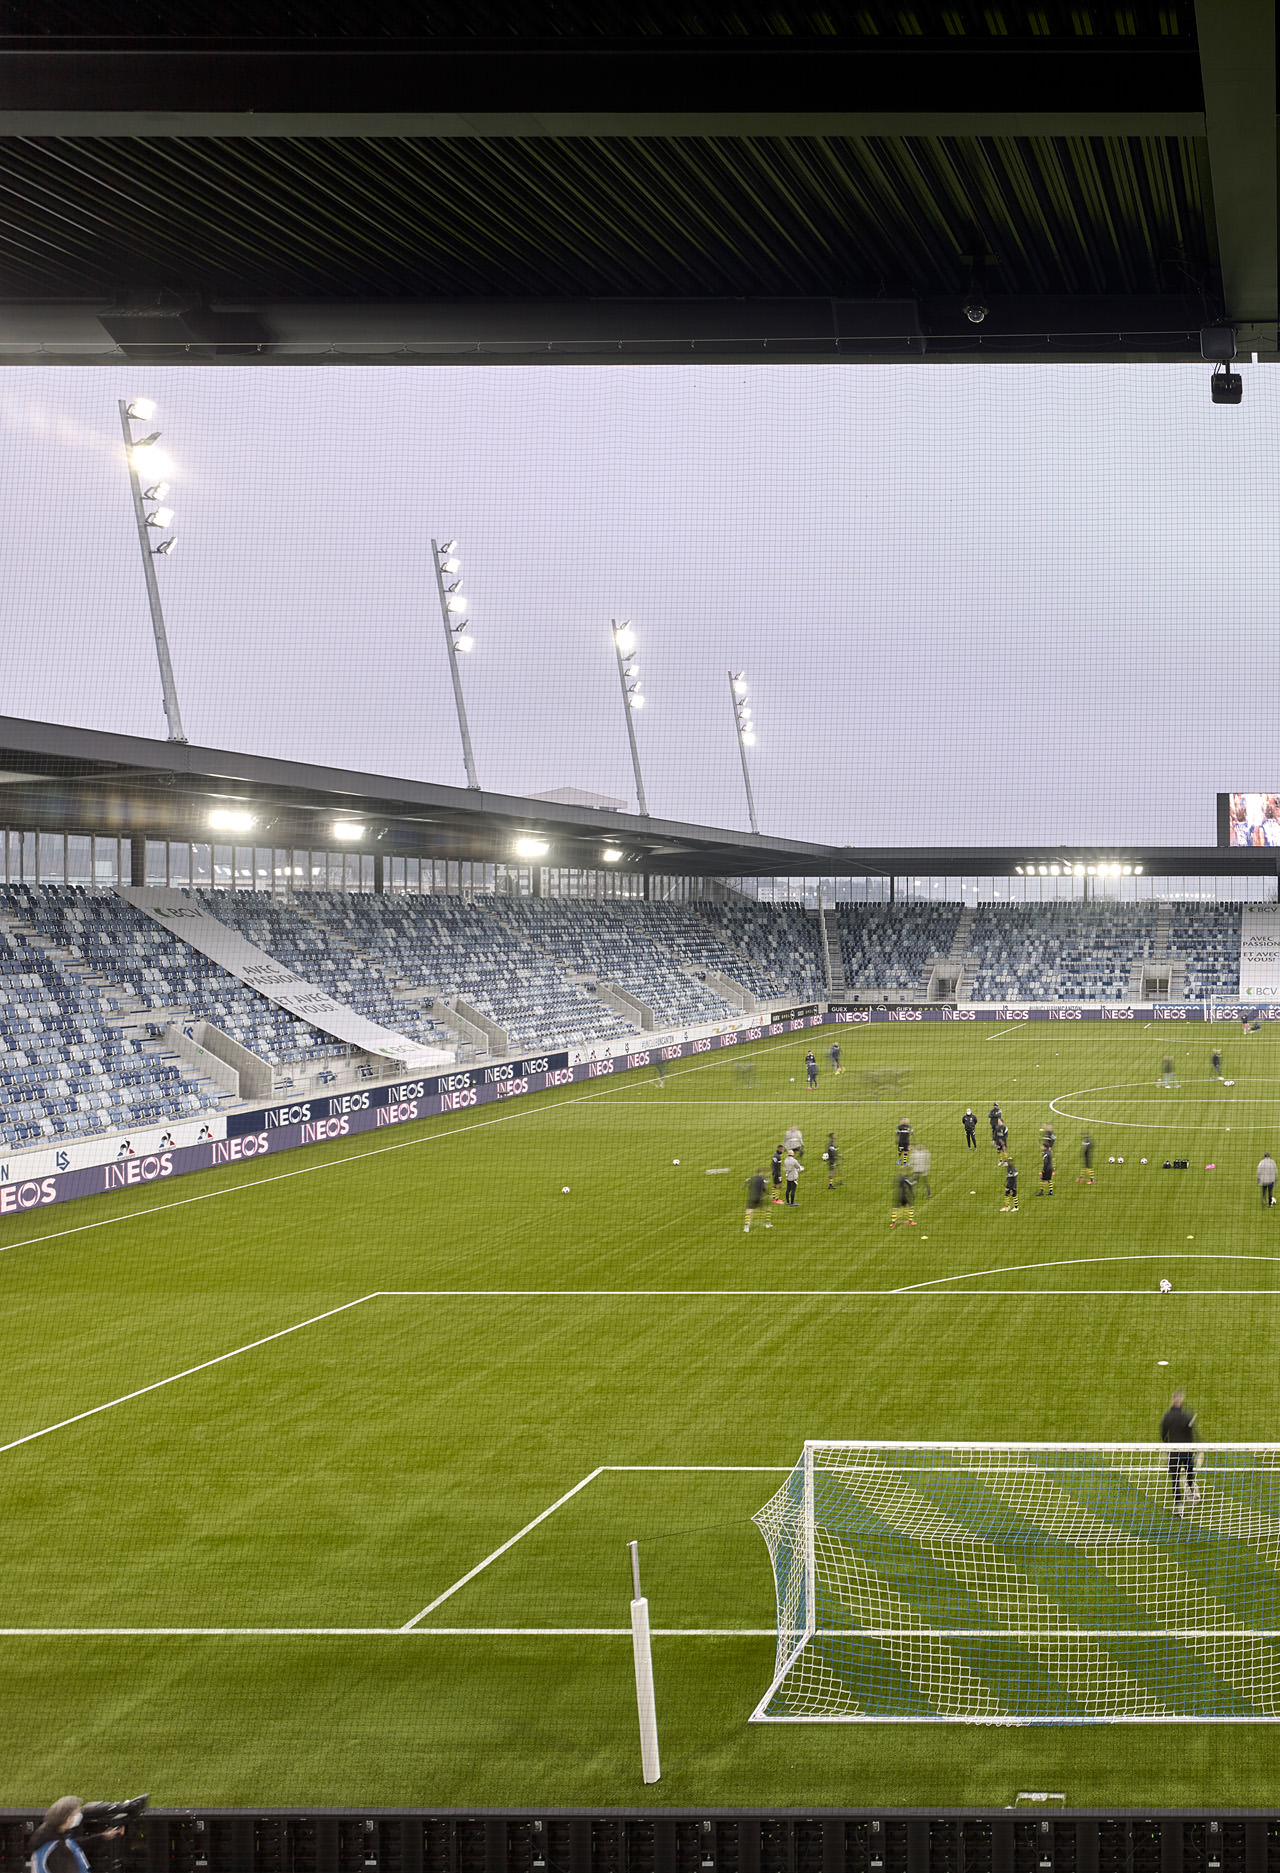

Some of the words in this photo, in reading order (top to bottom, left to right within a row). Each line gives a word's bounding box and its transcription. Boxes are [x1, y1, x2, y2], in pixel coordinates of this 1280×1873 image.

[168, 908, 203, 918] BCV
[242, 964, 280, 975] AVEC
[244, 974, 304, 986] PASSION
[1256, 987, 1278, 996] BCV
[274, 995, 294, 1006] ET
[294, 992, 323, 1004] AVEC
[294, 1003, 339, 1015] VOUS!
[888, 1010, 922, 1021] INEOS
[943, 1010, 976, 1020] INEOS
[996, 1010, 1029, 1020] INEOS
[1048, 1010, 1082, 1020] INEOS
[1101, 1010, 1134, 1020] INEOS
[1153, 1010, 1186, 1020] INEOS
[1206, 1010, 1239, 1019] INEOS
[810, 1014, 823, 1026] INEOS
[836, 1011, 869, 1022] INEOS
[768, 1023, 784, 1036] INEOS
[791, 1019, 804, 1031] INEOS
[720, 1033, 738, 1047] INEOS
[746, 1028, 762, 1040] INEOS
[661, 1045, 682, 1060] INEOS
[692, 1039, 711, 1054] INEOS
[522, 1057, 549, 1076] INEOS
[627, 1052, 650, 1069] INEOS
[484, 1064, 514, 1083] INEOS
[588, 1059, 614, 1077] INEOS
[438, 1073, 471, 1093] INEOS
[545, 1068, 574, 1087] INEOS
[388, 1081, 424, 1103] INEOS
[497, 1078, 529, 1099] INEOS
[329, 1092, 370, 1116] INEOS
[440, 1088, 477, 1112] INEOS
[264, 1104, 311, 1130] INEOS
[376, 1101, 418, 1126] INEOS
[301, 1116, 350, 1144] INEOS
[211, 1132, 269, 1165] INEOS
[104, 1153, 173, 1190] INEOS
[0, 1178, 57, 1213] EOS
